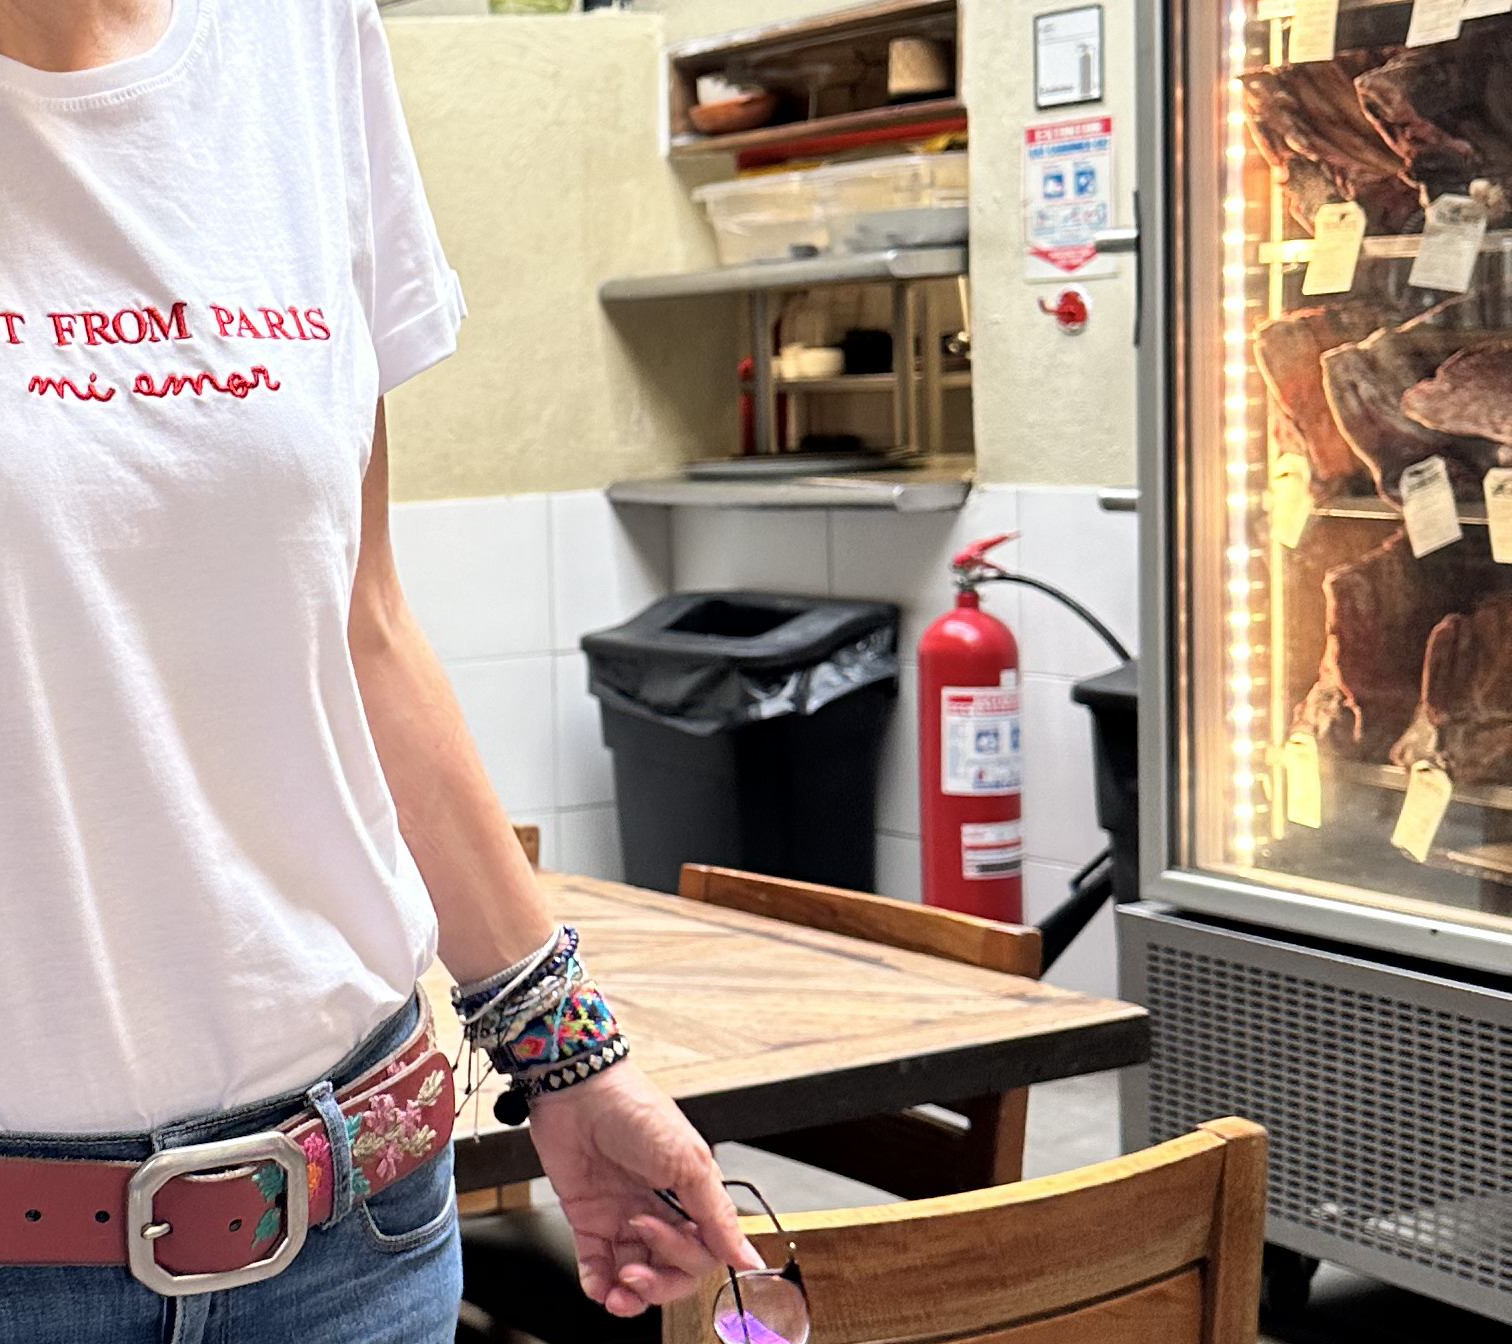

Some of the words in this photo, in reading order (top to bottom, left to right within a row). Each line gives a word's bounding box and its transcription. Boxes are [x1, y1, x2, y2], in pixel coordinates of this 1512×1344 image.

[47, 302, 193, 347] FROM
[210, 303, 331, 341] PARIS
[28, 373, 116, 403] mi
[134, 364, 281, 399] amor
